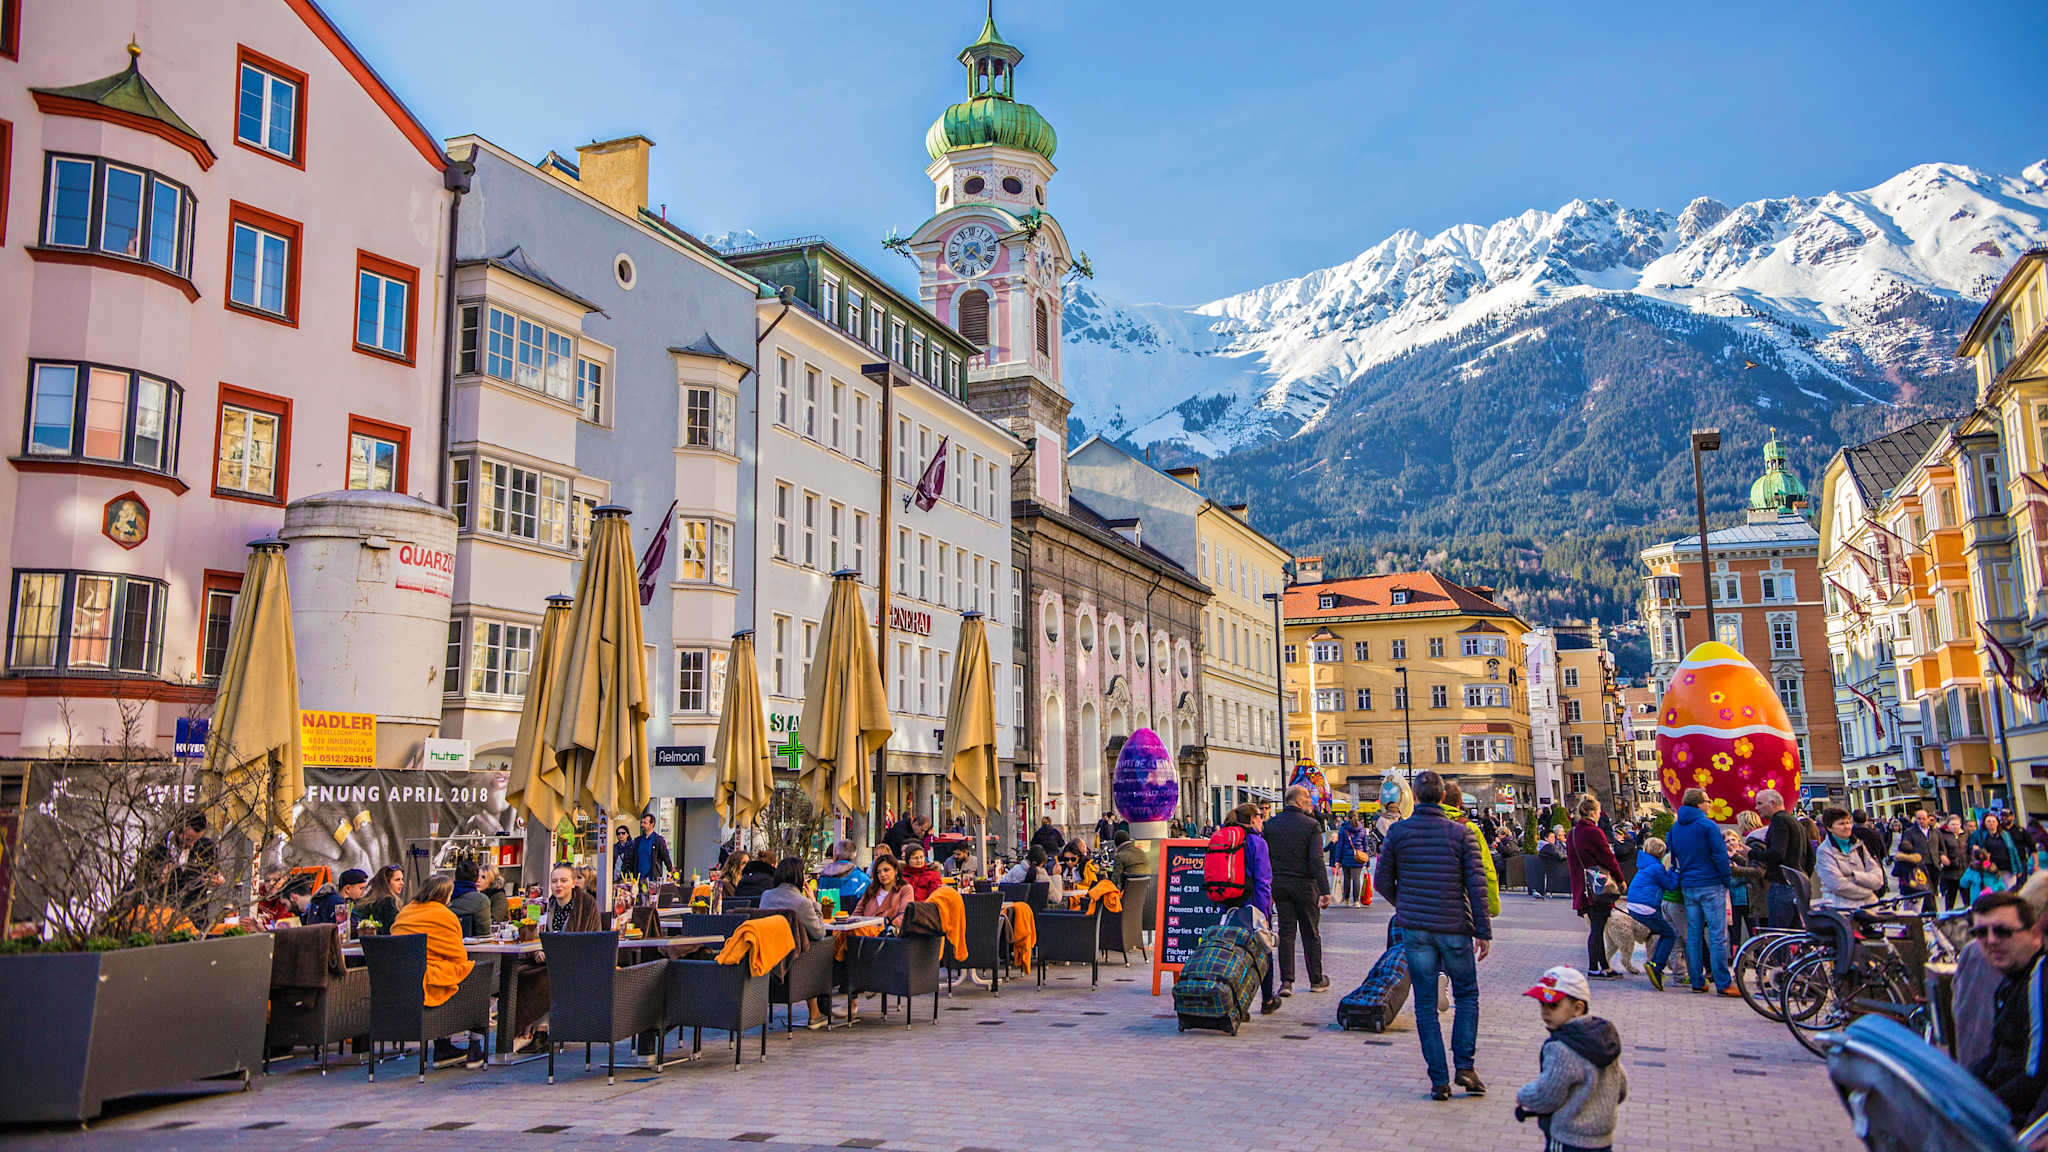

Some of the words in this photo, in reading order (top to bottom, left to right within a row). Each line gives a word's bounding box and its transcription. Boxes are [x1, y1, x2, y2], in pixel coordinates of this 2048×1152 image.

[302, 713, 373, 730] NADLER
[430, 750, 465, 761] huter
[144, 784, 202, 805] WIE
[388, 787, 445, 803] APRIL
[450, 787, 489, 803] 2018
